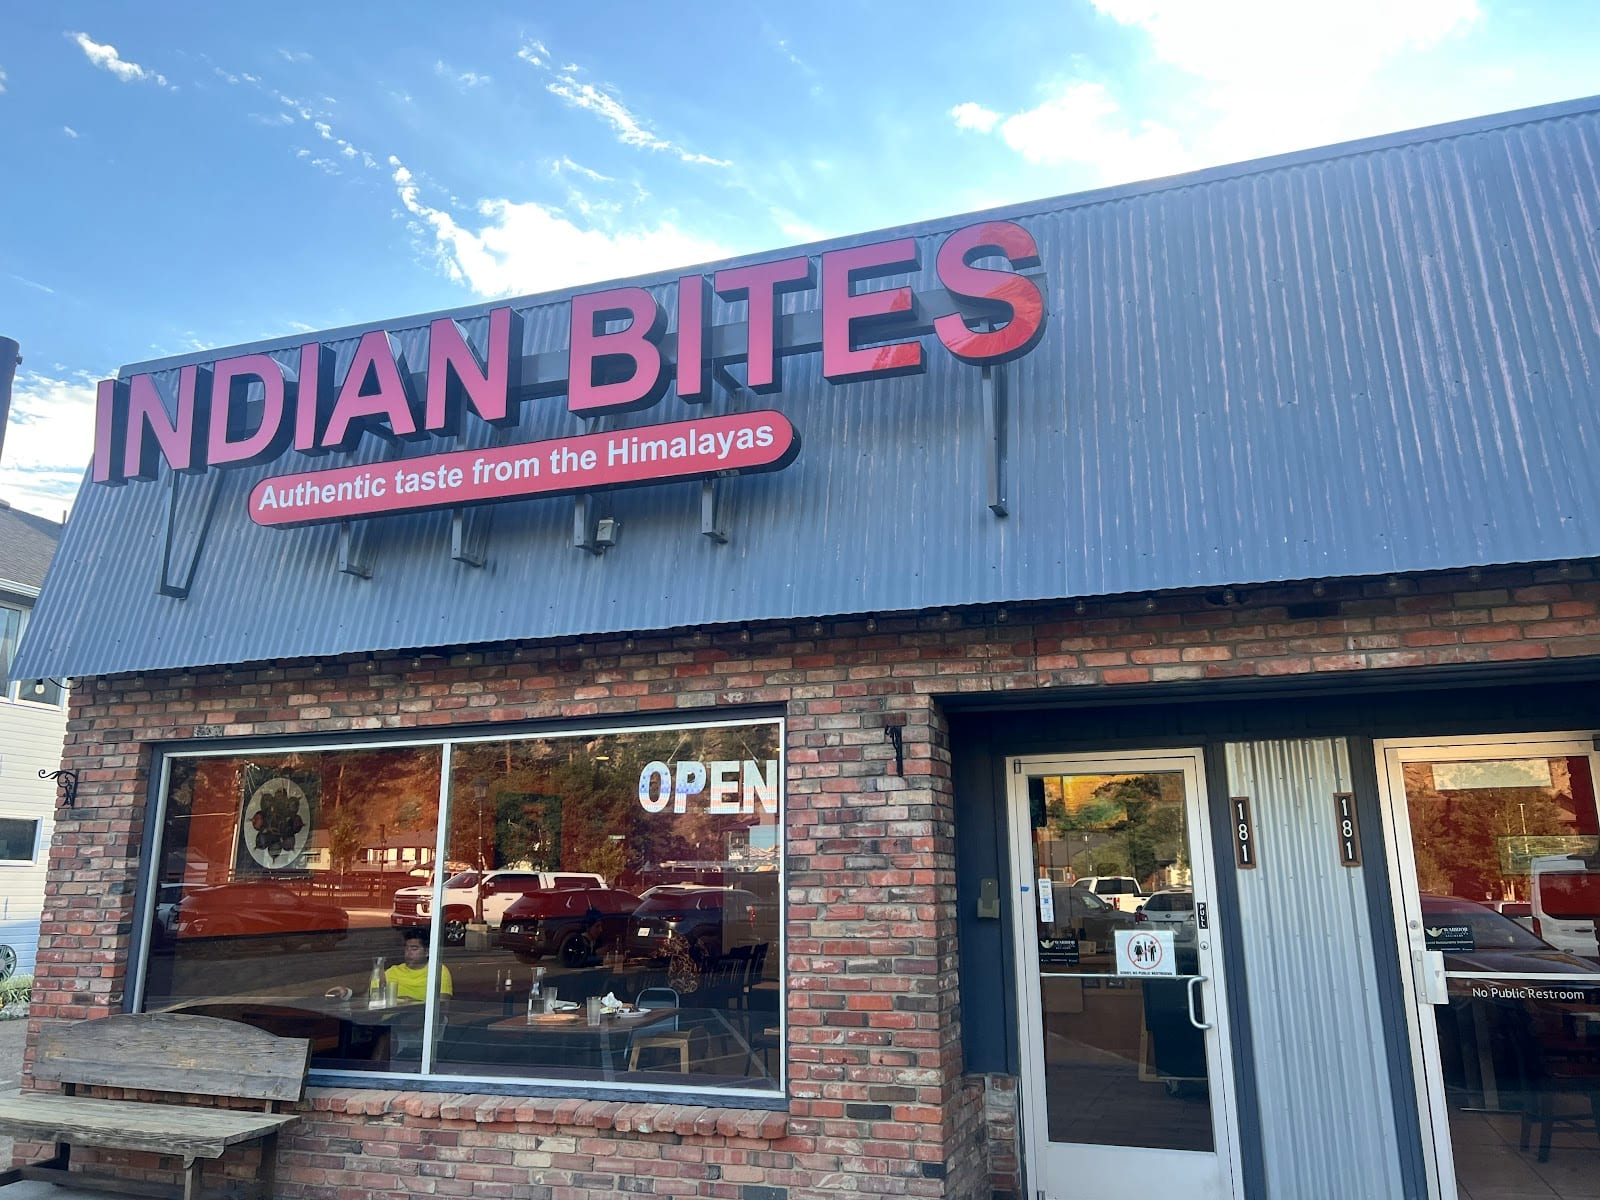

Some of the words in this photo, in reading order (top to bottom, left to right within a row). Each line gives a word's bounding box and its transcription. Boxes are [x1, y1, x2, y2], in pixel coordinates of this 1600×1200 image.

[92, 306, 518, 484] INDIAN
[567, 220, 1044, 414] BITES
[258, 473, 386, 511] Authentic
[395, 463, 463, 494] taste
[472, 458, 540, 485] from
[549, 447, 598, 475] the
[607, 423, 775, 467] Himalayas
[638, 759, 778, 814] OPEN
[1237, 802, 1250, 863] 181
[1341, 798, 1354, 860] 181
[1198, 902, 1207, 929] PULL
[1472, 987, 1488, 998] No
[1491, 987, 1526, 999] Public
[1528, 988, 1585, 1000] Restroom
